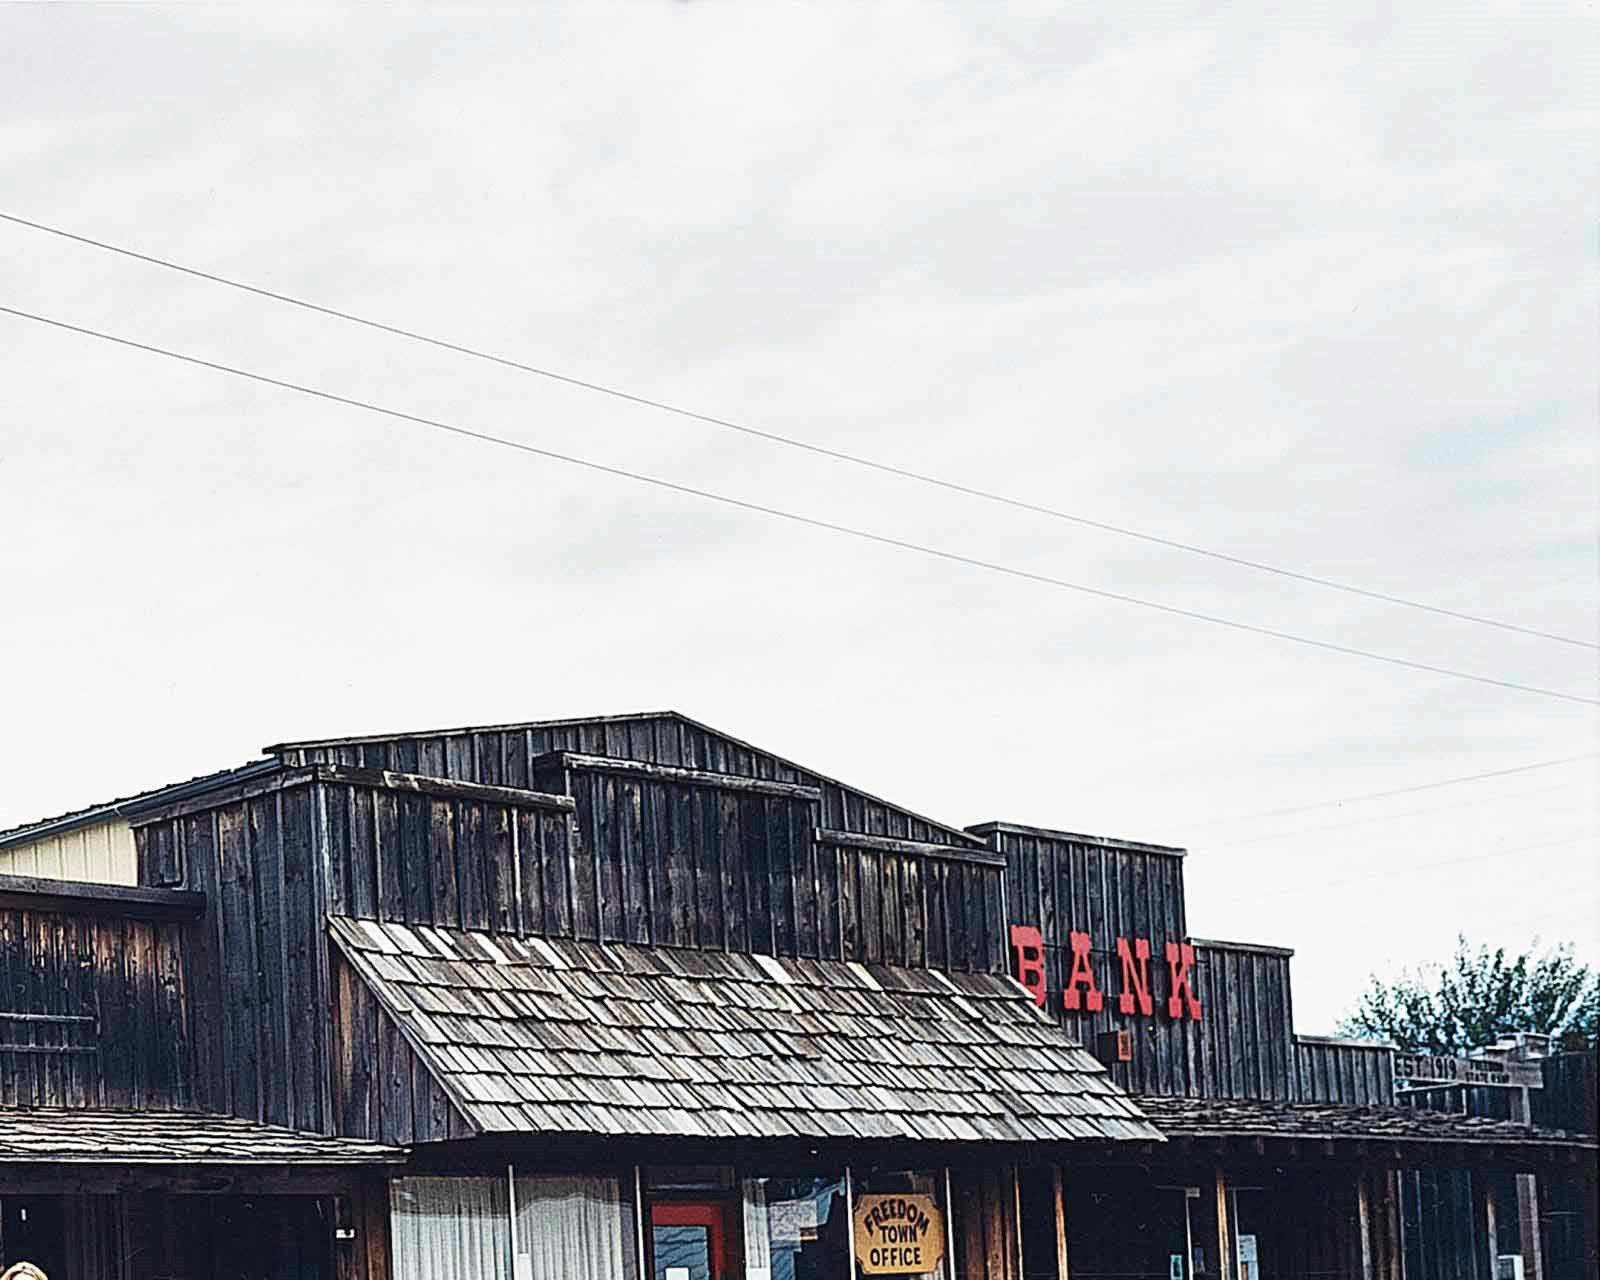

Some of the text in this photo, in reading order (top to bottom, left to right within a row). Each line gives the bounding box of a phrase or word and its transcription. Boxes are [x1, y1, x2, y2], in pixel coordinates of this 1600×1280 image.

[1010, 924, 1202, 1021] BANK
[1430, 1056, 1457, 1080] 1919
[864, 1198, 930, 1237] FREEDOM
[879, 1224, 918, 1244] TOWN
[870, 1247, 922, 1266] OFFICE
